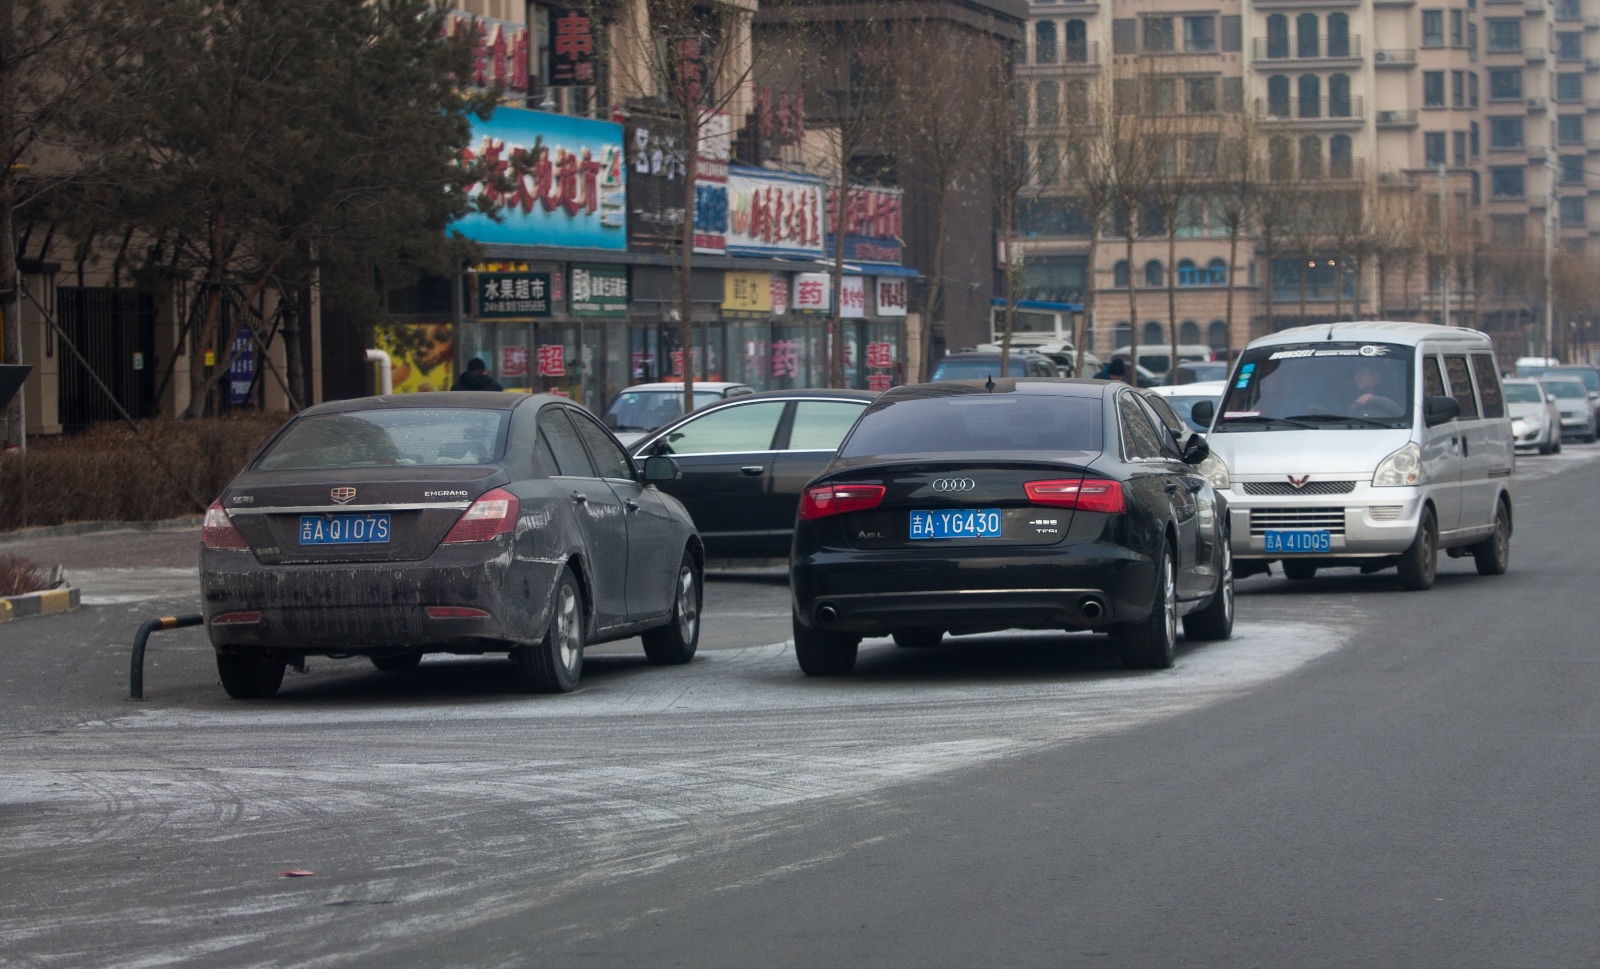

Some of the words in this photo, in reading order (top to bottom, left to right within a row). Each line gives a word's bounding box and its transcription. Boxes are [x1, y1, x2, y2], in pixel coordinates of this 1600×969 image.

[555, 10, 592, 60] 串
[485, 278, 545, 299] 水果超市
[799, 281, 823, 305] 药
[303, 518, 388, 540] 吉A·Q107S
[912, 513, 999, 534] 吉A·YG430
